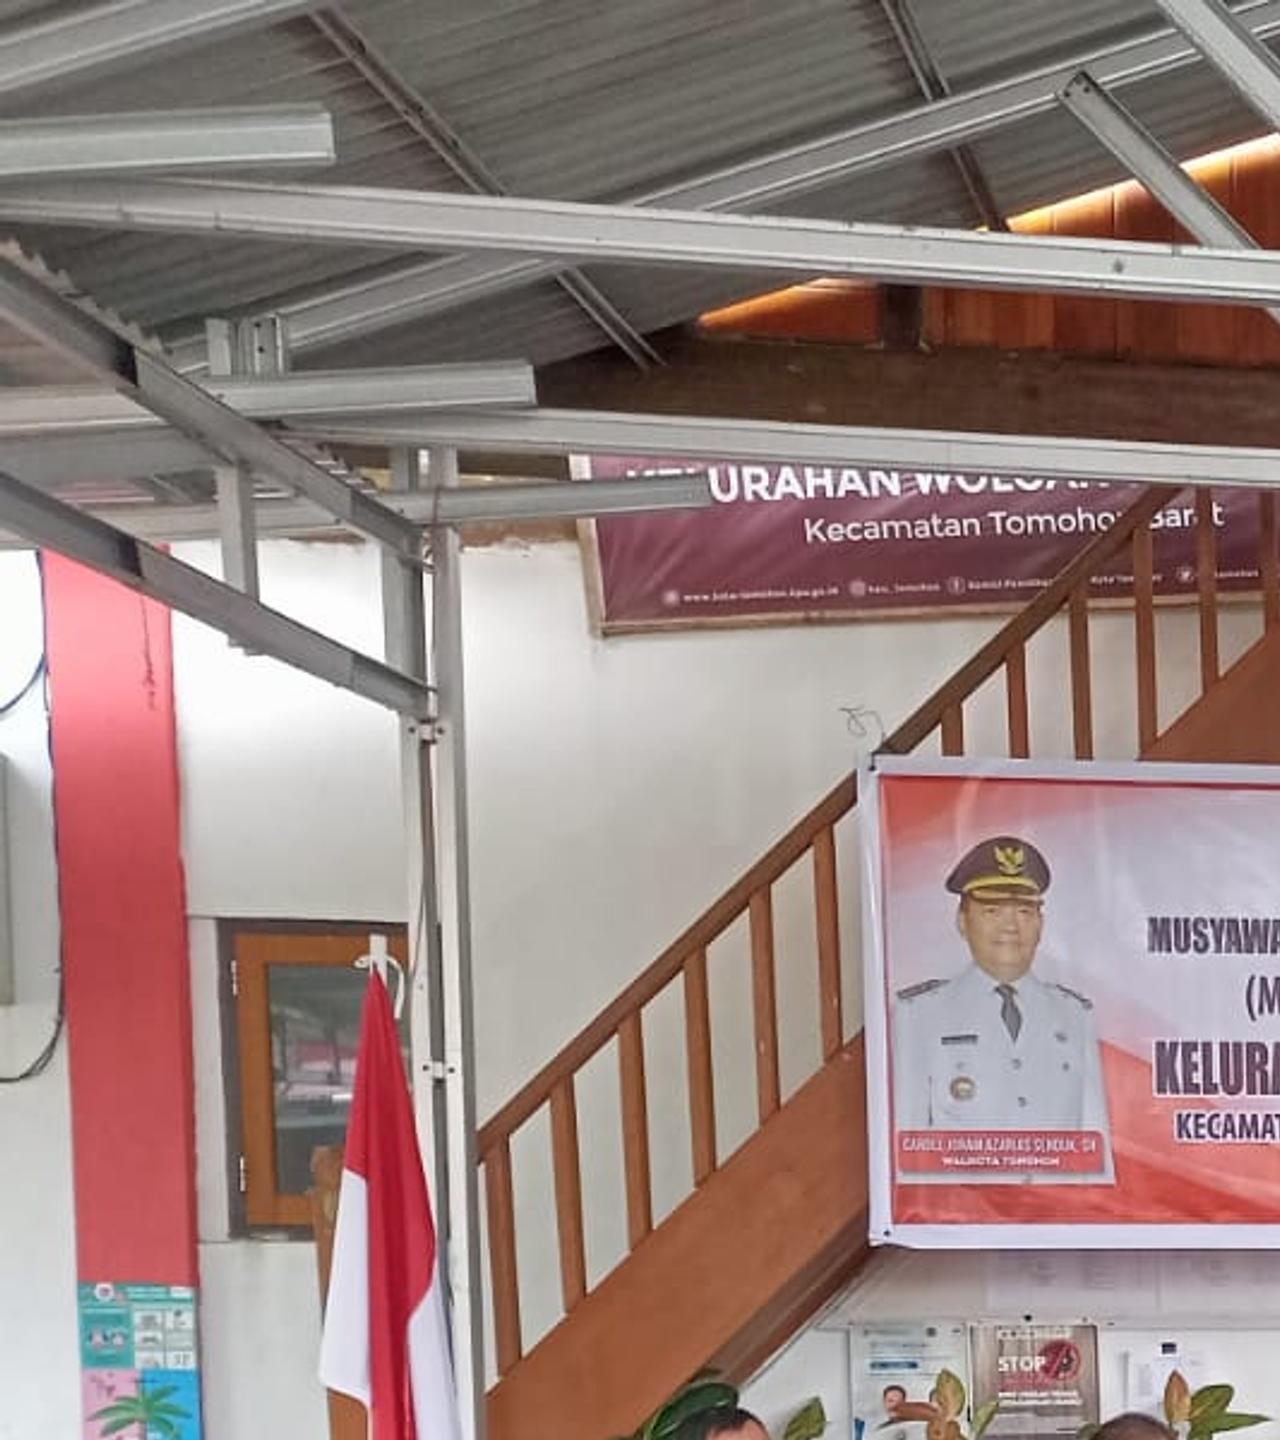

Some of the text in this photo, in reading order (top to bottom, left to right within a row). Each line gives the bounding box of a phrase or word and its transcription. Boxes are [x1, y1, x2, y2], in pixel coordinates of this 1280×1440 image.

[627, 466, 900, 502] URAHAN
[804, 502, 1224, 543] Kecamatan Tomoho art
[998, 1355, 1046, 1372] STOP
